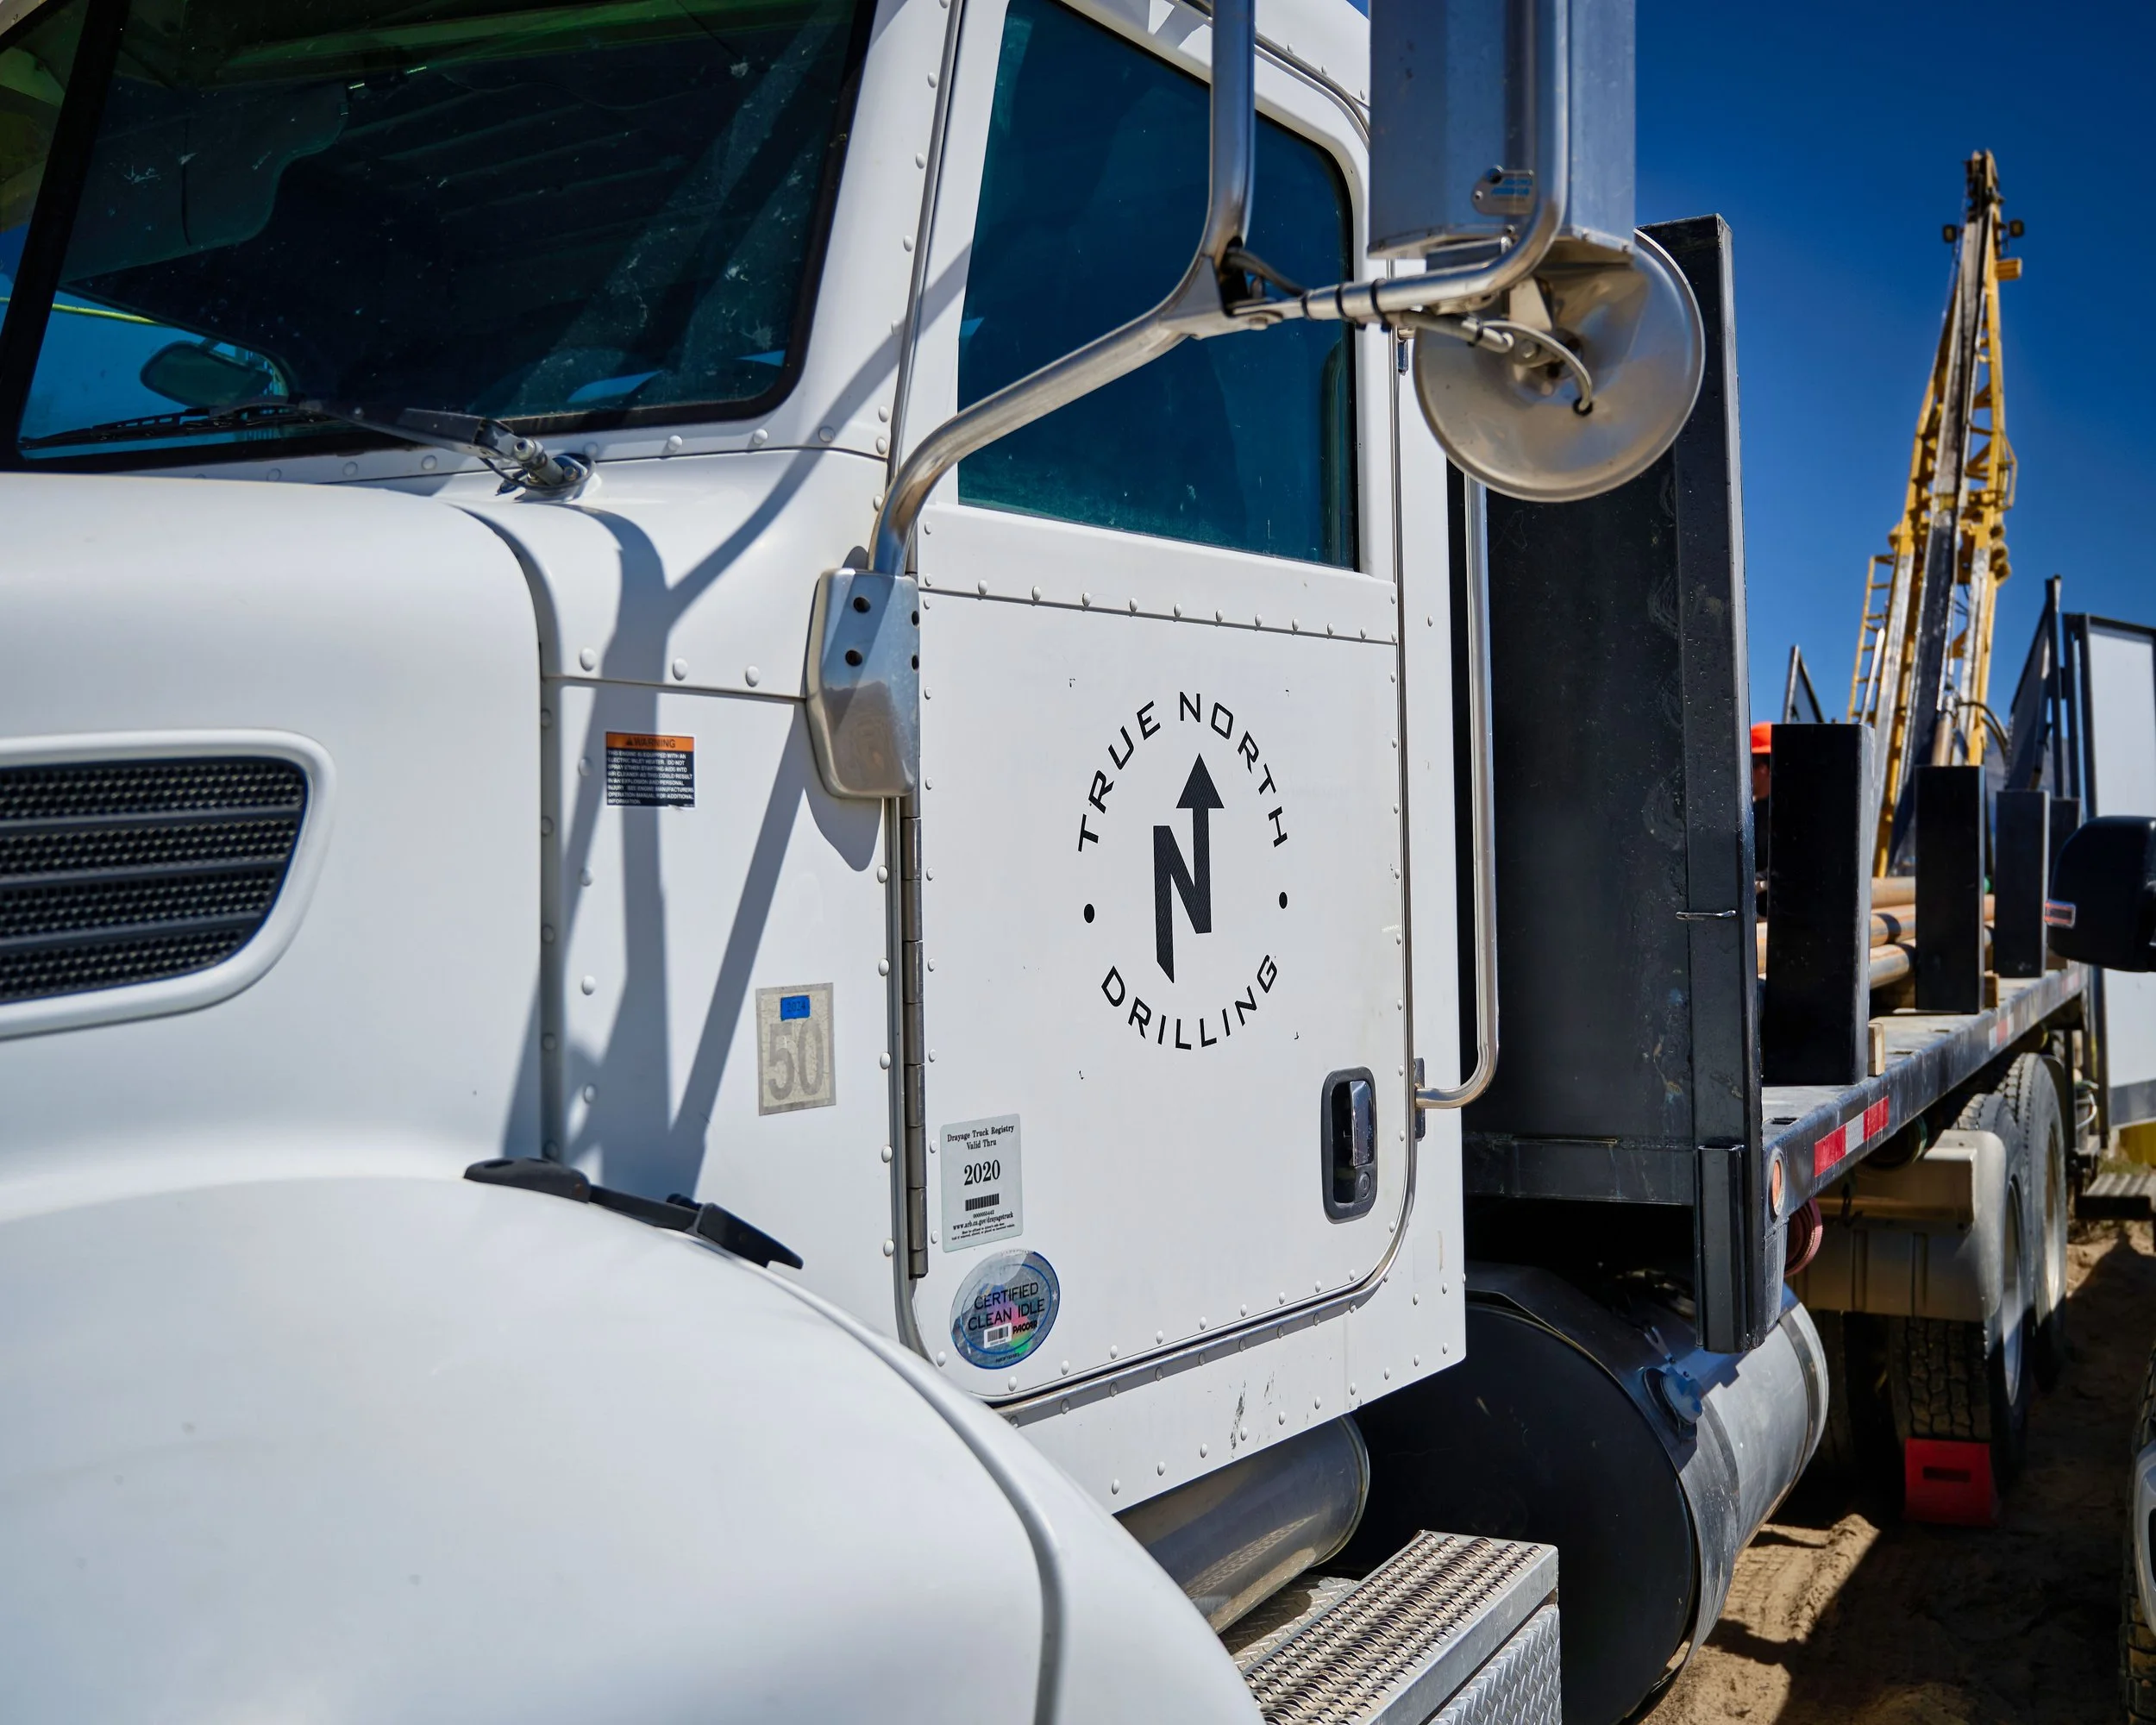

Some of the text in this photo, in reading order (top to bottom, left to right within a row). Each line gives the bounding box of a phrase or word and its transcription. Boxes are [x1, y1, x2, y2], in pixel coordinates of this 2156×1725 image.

[634, 737, 675, 748] WARNING
[1078, 692, 1288, 852] TRUE NORTH
[1101, 955, 1277, 1050] DRILLING
[768, 1018, 824, 1101] 50
[947, 1125, 1014, 1143] Drayage Truck Registry
[967, 1139, 997, 1150] Valid Thru
[964, 1159, 1000, 1186] 2020
[975, 1282, 1039, 1310] CERTIFIED
[968, 1298, 1045, 1331] CLEAN IDLE
[1012, 1320, 1038, 1334] PACCAR
